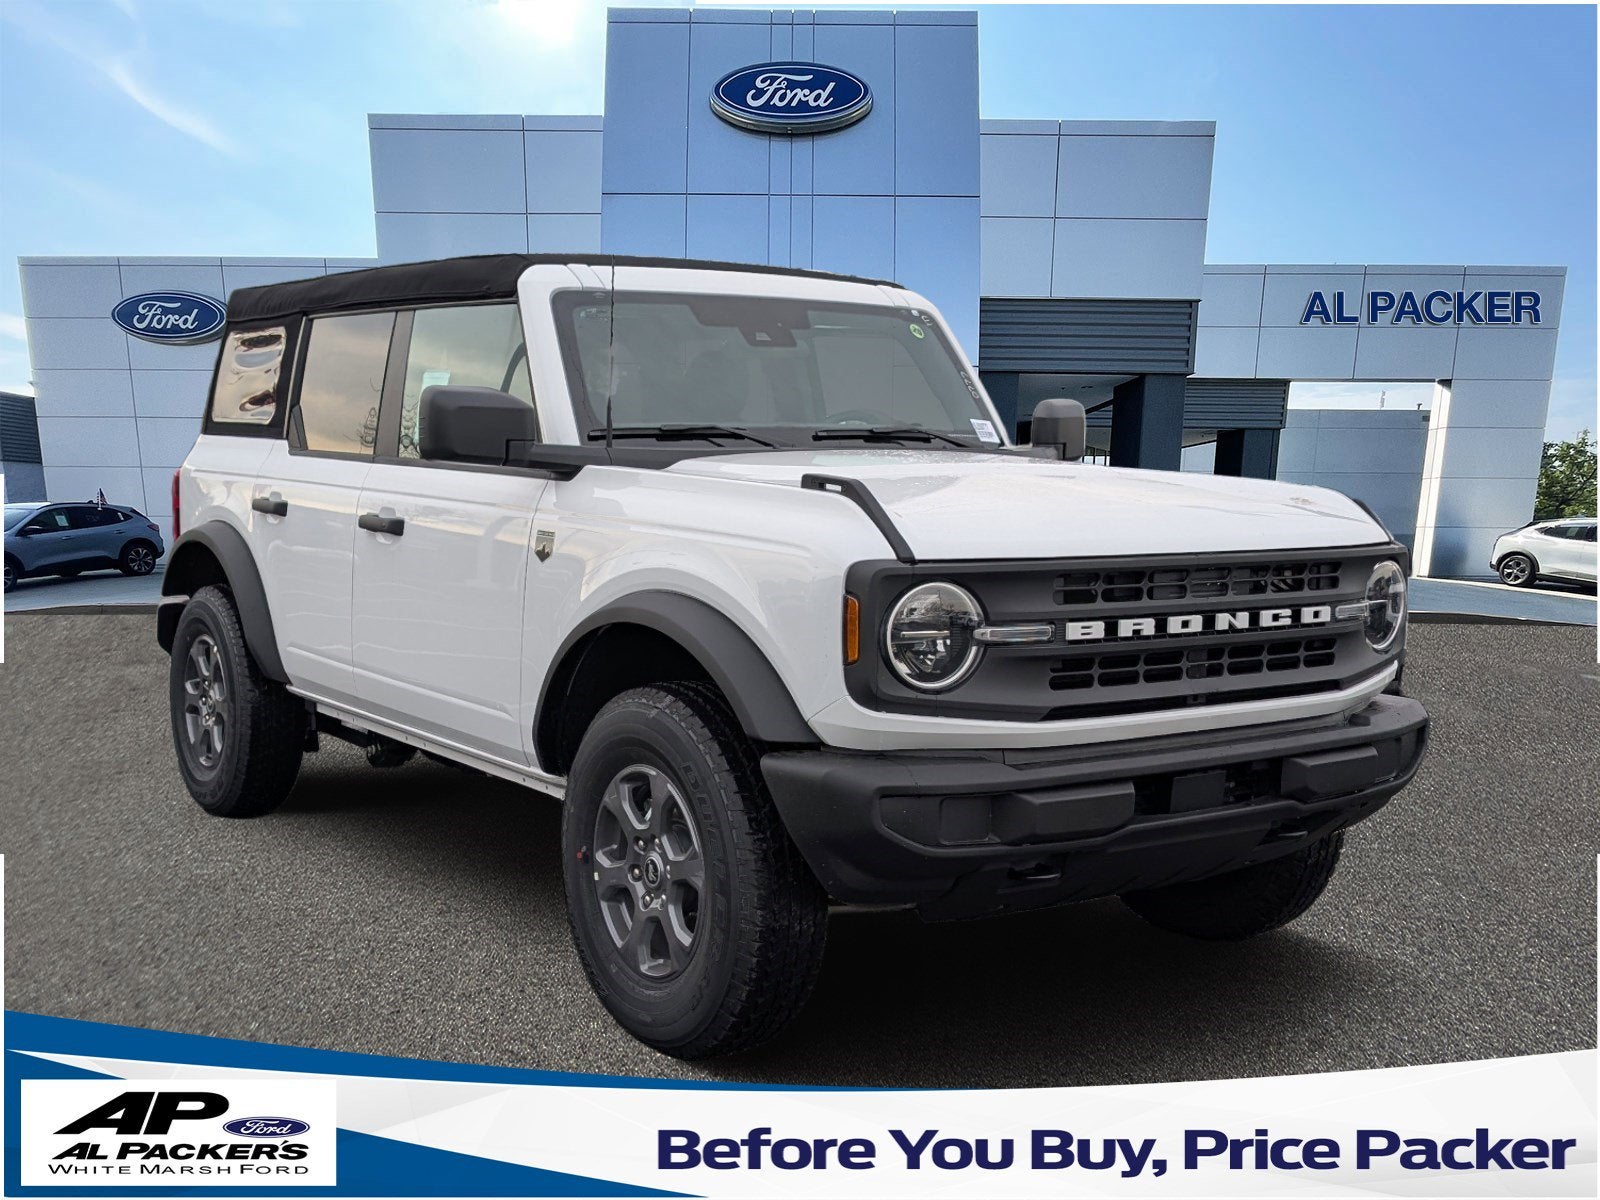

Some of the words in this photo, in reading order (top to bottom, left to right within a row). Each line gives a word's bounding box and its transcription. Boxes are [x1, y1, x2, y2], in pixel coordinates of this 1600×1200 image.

[746, 73, 836, 107] Ford
[133, 301, 199, 329] Ford
[1302, 290, 1360, 324] AL
[1368, 290, 1542, 325] PACKER
[1065, 605, 1331, 641] BRONCO
